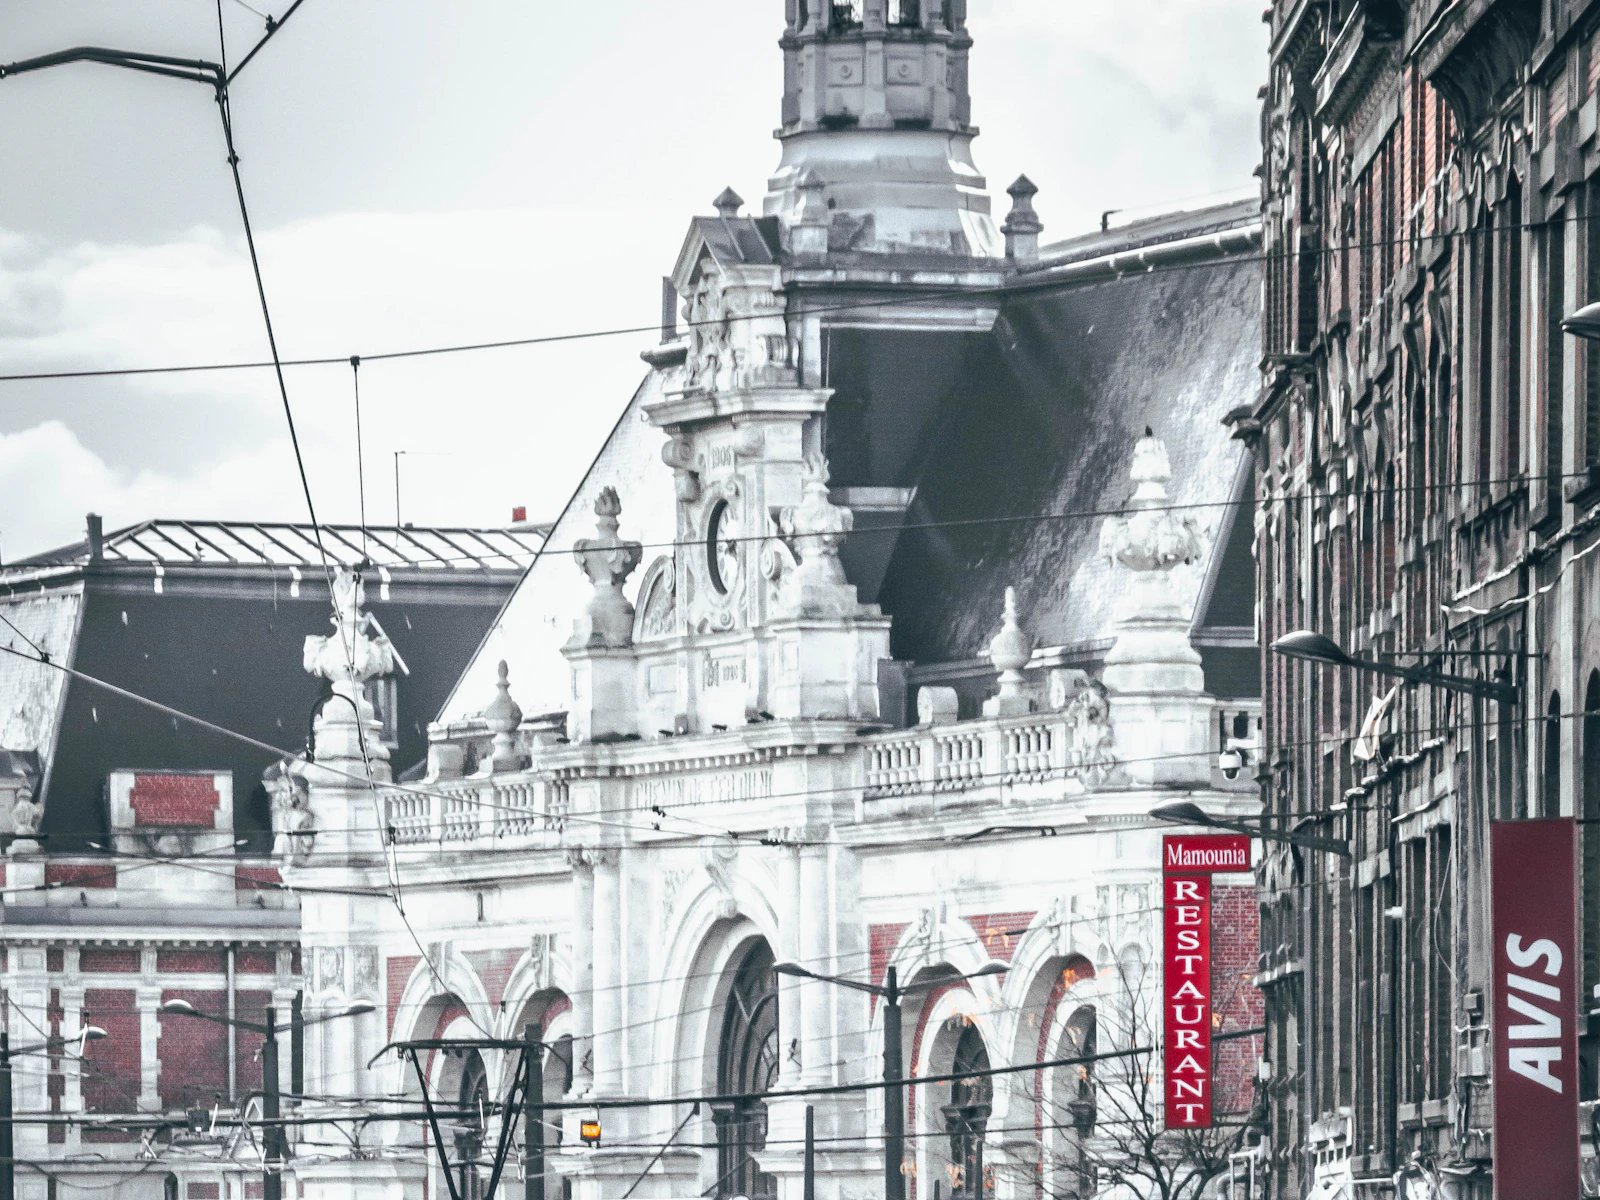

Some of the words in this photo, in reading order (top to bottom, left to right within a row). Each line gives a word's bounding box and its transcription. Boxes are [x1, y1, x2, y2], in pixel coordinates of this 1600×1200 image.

[1167, 842, 1246, 866] Mamounia
[1172, 880, 1206, 1123] RESTAURANT
[1505, 932, 1563, 1094] AVIS
